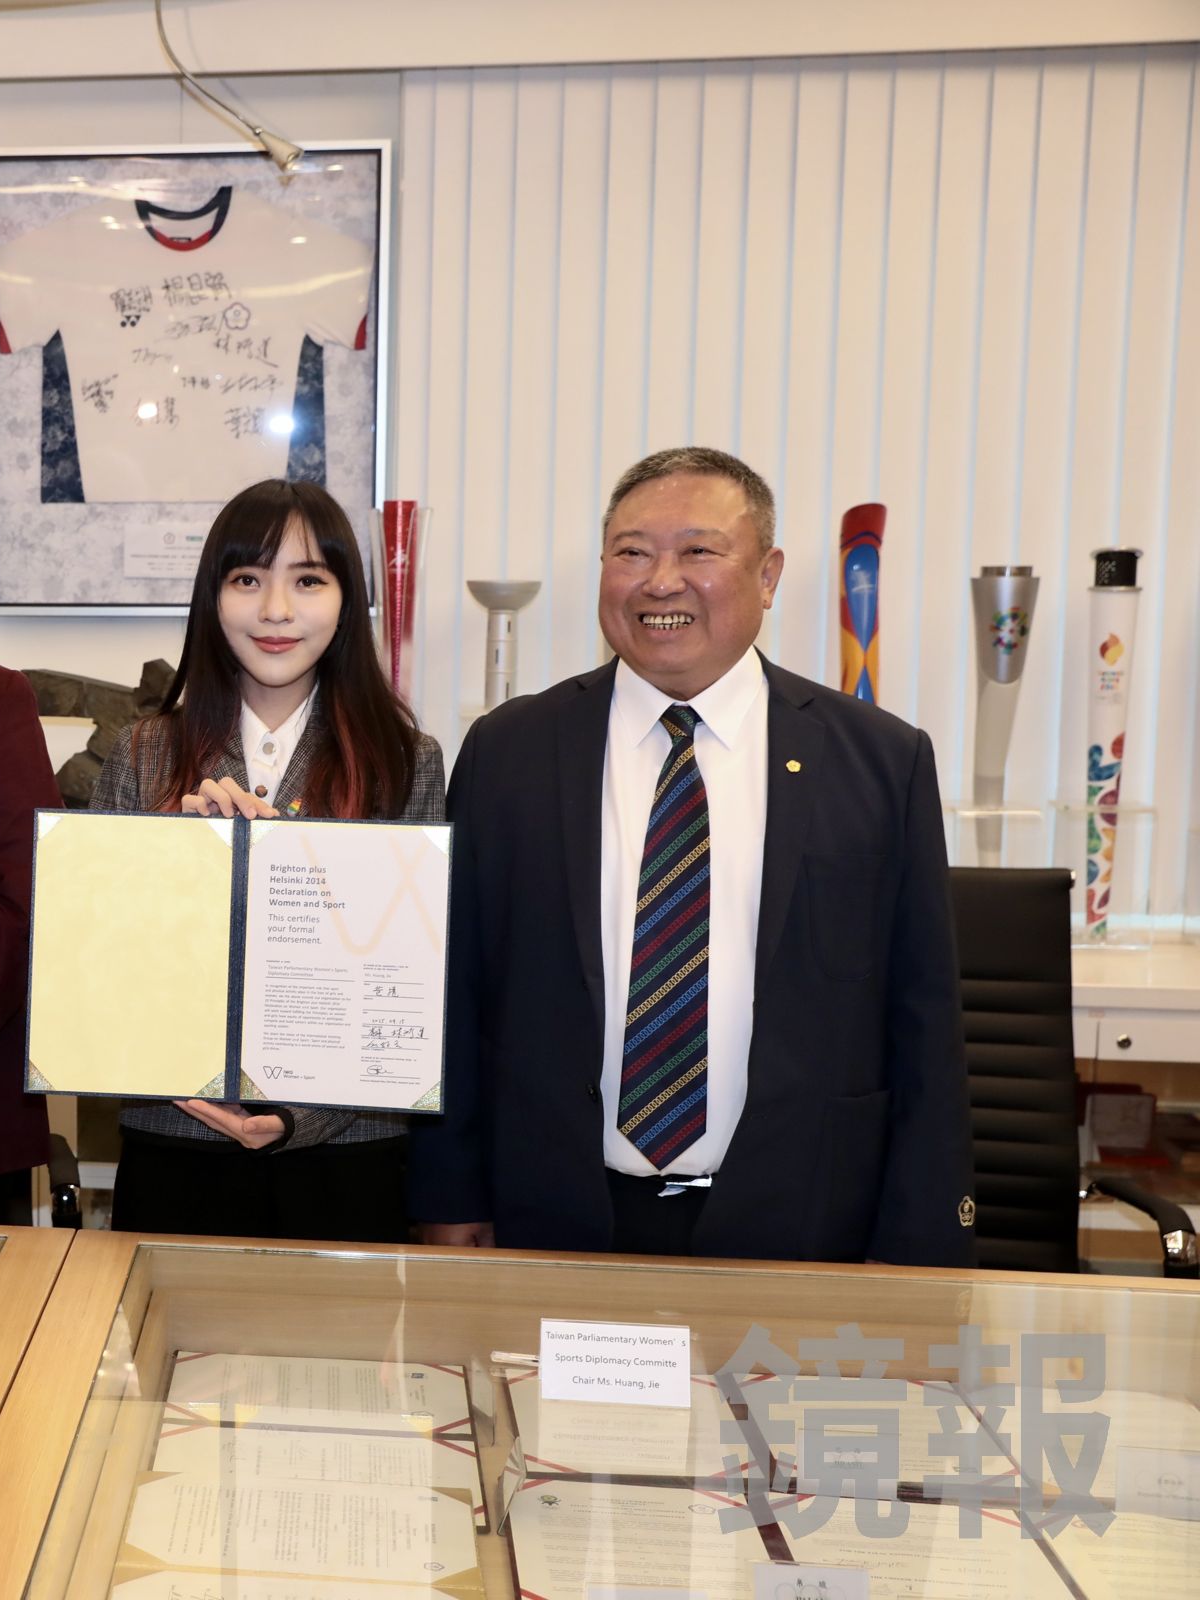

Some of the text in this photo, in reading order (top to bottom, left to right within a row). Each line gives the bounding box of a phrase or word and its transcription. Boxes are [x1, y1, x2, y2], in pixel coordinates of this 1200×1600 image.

[270, 864, 306, 873] Brighton
[269, 887, 318, 896] Declaration
[269, 899, 301, 907] Women
[323, 901, 345, 910] Sport
[287, 915, 320, 923] certifies
[289, 925, 315, 933] formal
[268, 936, 322, 944] endorsement.
[546, 1331, 575, 1340] Taiwan
[577, 1333, 636, 1346] Parliamentary
[555, 1353, 677, 1368] Sports Diplomacy Committe
[572, 1376, 594, 1385] Chair
[597, 1378, 612, 1386] Ms.
[648, 1380, 660, 1389] Jie
